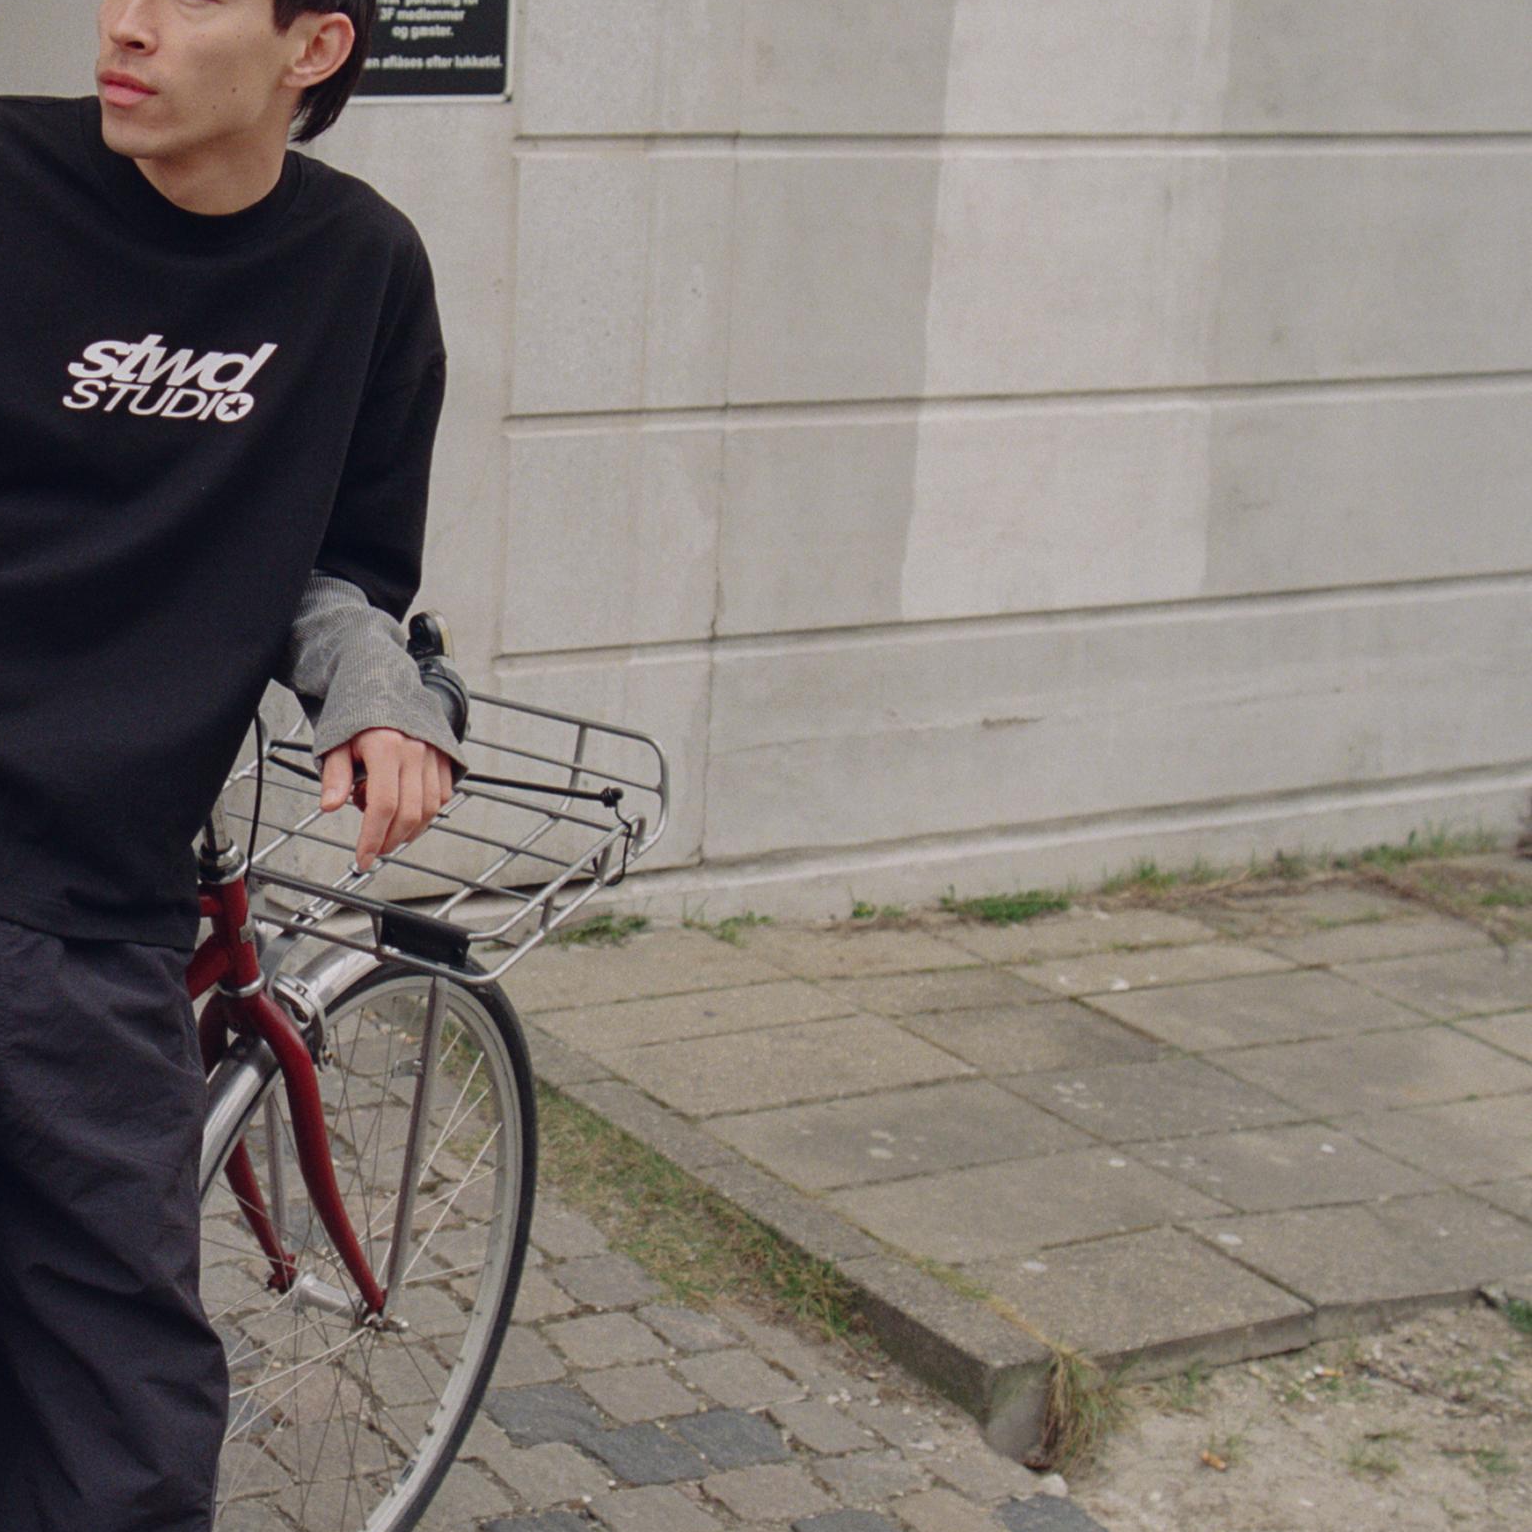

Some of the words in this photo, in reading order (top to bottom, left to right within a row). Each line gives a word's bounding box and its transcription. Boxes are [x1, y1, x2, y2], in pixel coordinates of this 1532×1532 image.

[396, 7, 466, 21] medlemmer
[391, 25, 409, 40] og
[425, 55, 453, 68] efter
[67, 334, 278, 392] stwd
[62, 379, 254, 422] STUDIO
